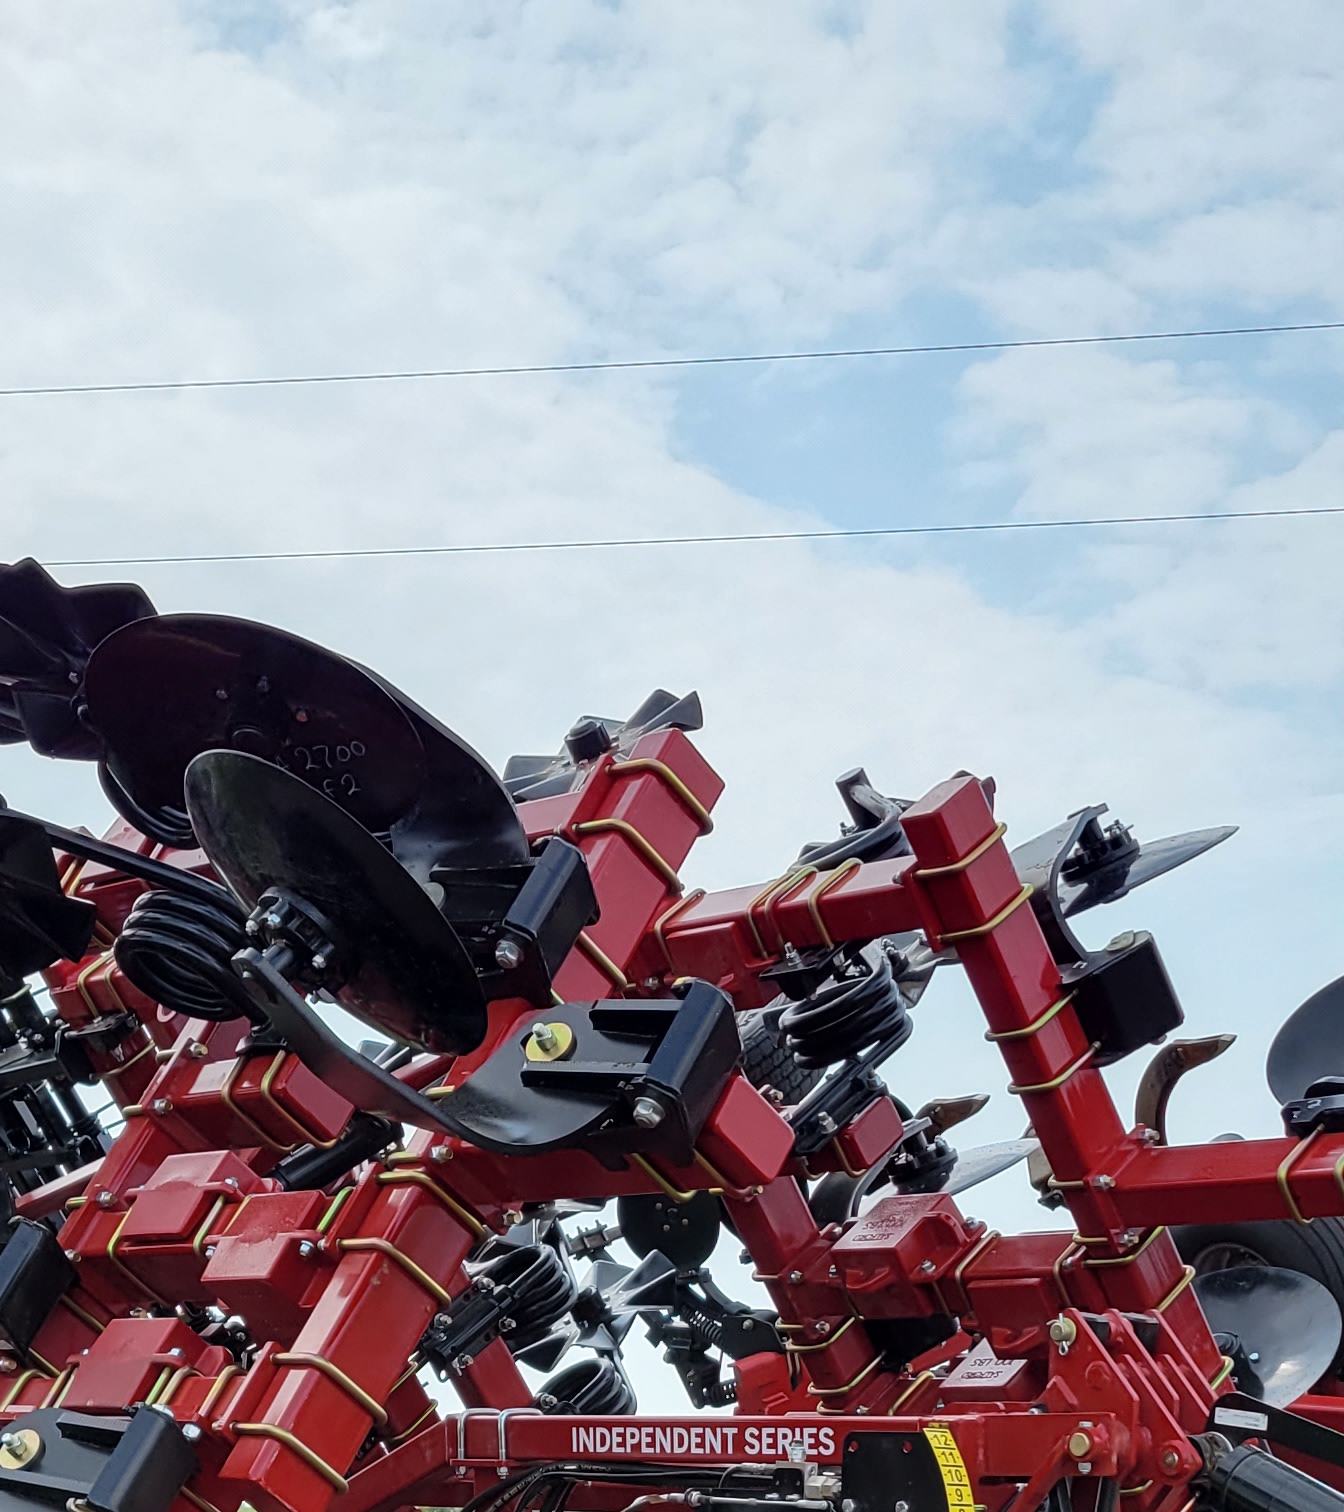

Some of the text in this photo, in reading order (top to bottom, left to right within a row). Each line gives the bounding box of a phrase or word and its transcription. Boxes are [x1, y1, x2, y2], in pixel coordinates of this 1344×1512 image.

[571, 1426, 836, 1456] INDEPENDENT SERIES
[932, 1434, 951, 1447] 12
[941, 1451, 957, 1464] 11
[947, 1470, 963, 1482] 10
[955, 1489, 964, 1502] 9
